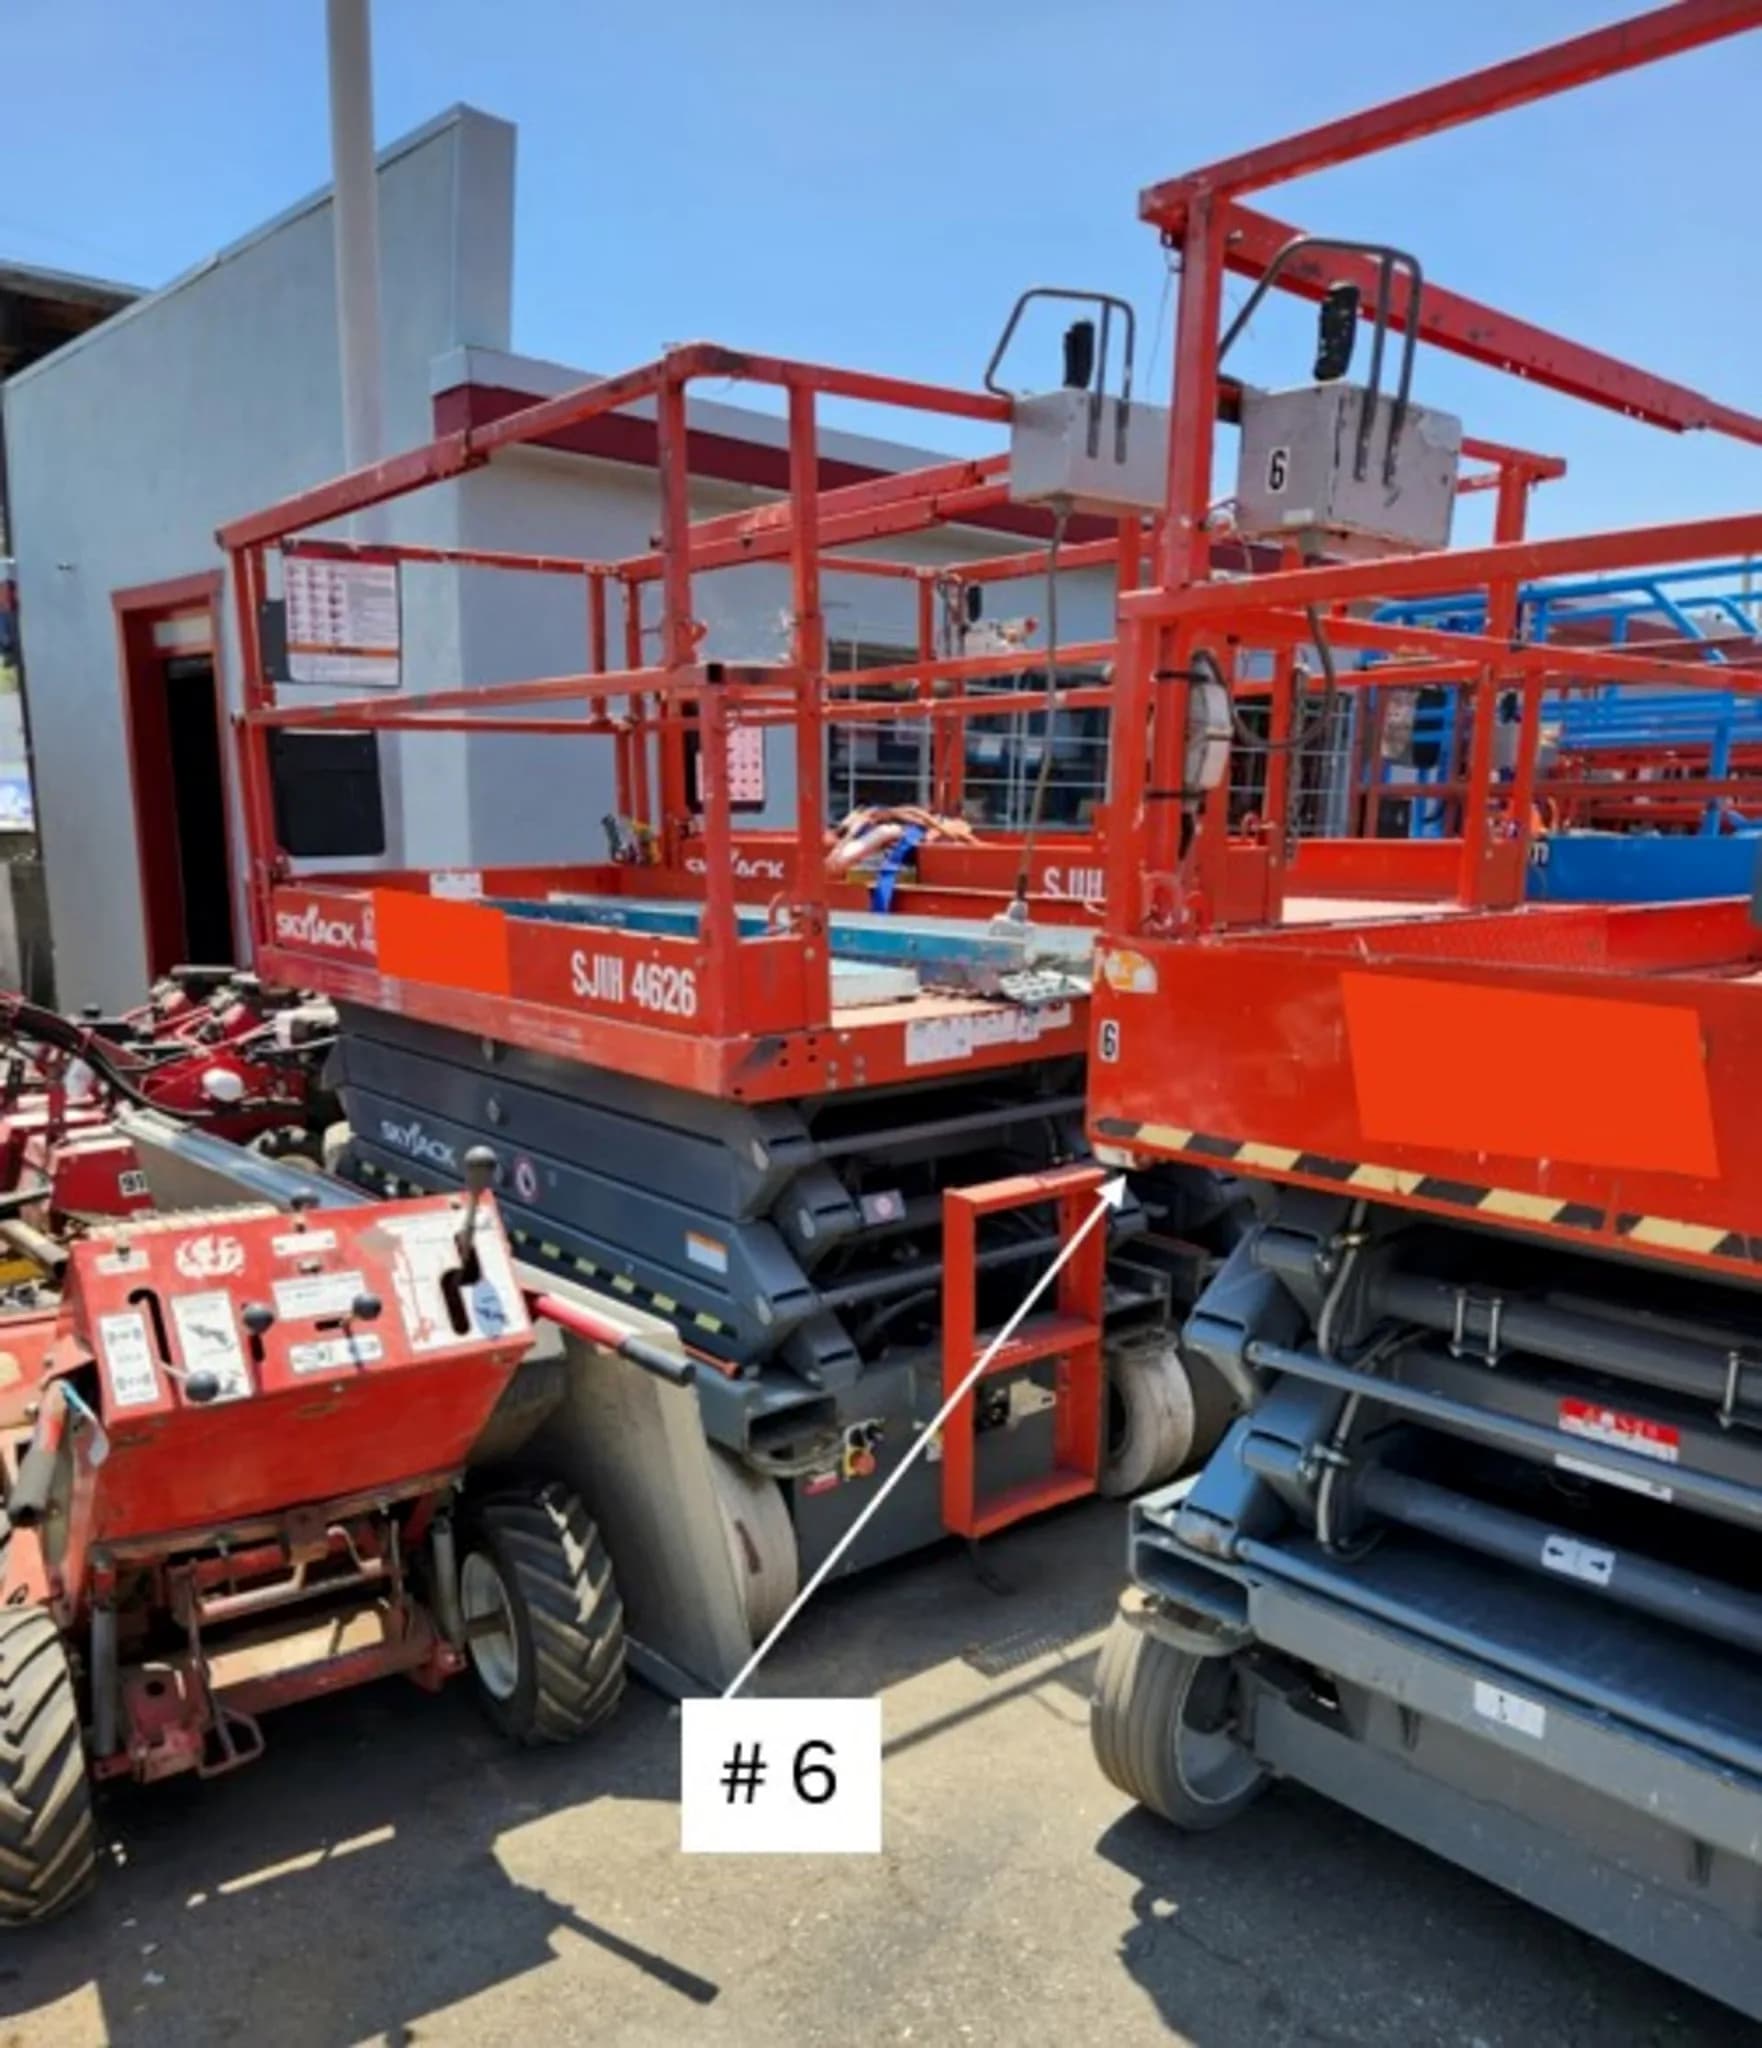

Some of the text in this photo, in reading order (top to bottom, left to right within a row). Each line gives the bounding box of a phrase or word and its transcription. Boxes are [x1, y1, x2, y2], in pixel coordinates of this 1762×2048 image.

[1269, 449, 1286, 490] 6
[631, 961, 697, 1018] 4626
[1103, 1023, 1116, 1057] 6
